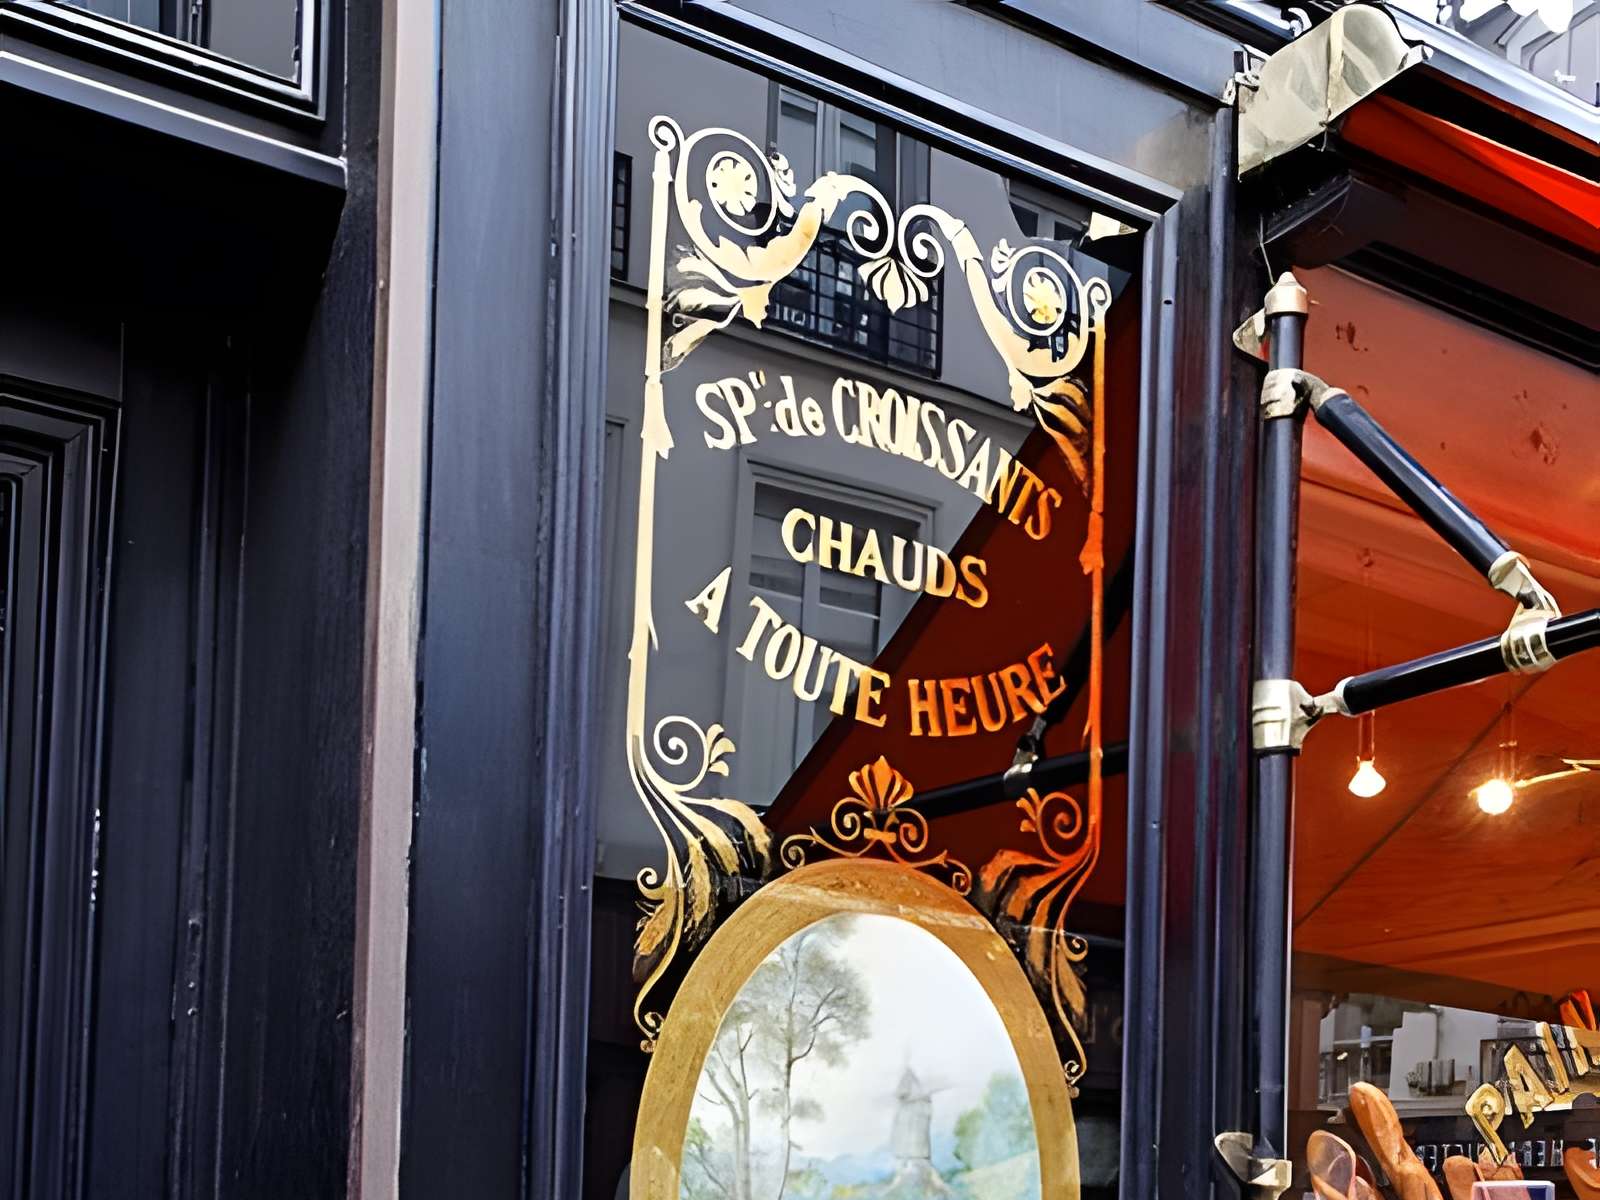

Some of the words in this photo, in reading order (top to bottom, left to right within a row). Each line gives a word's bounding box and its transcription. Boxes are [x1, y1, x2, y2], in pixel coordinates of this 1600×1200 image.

[831, 377, 1062, 541] CROISSANTS
[781, 508, 989, 608] CHAUDS
[684, 566, 732, 634] A
[736, 596, 891, 728] TOUTE
[908, 642, 1067, 737] HEURE
